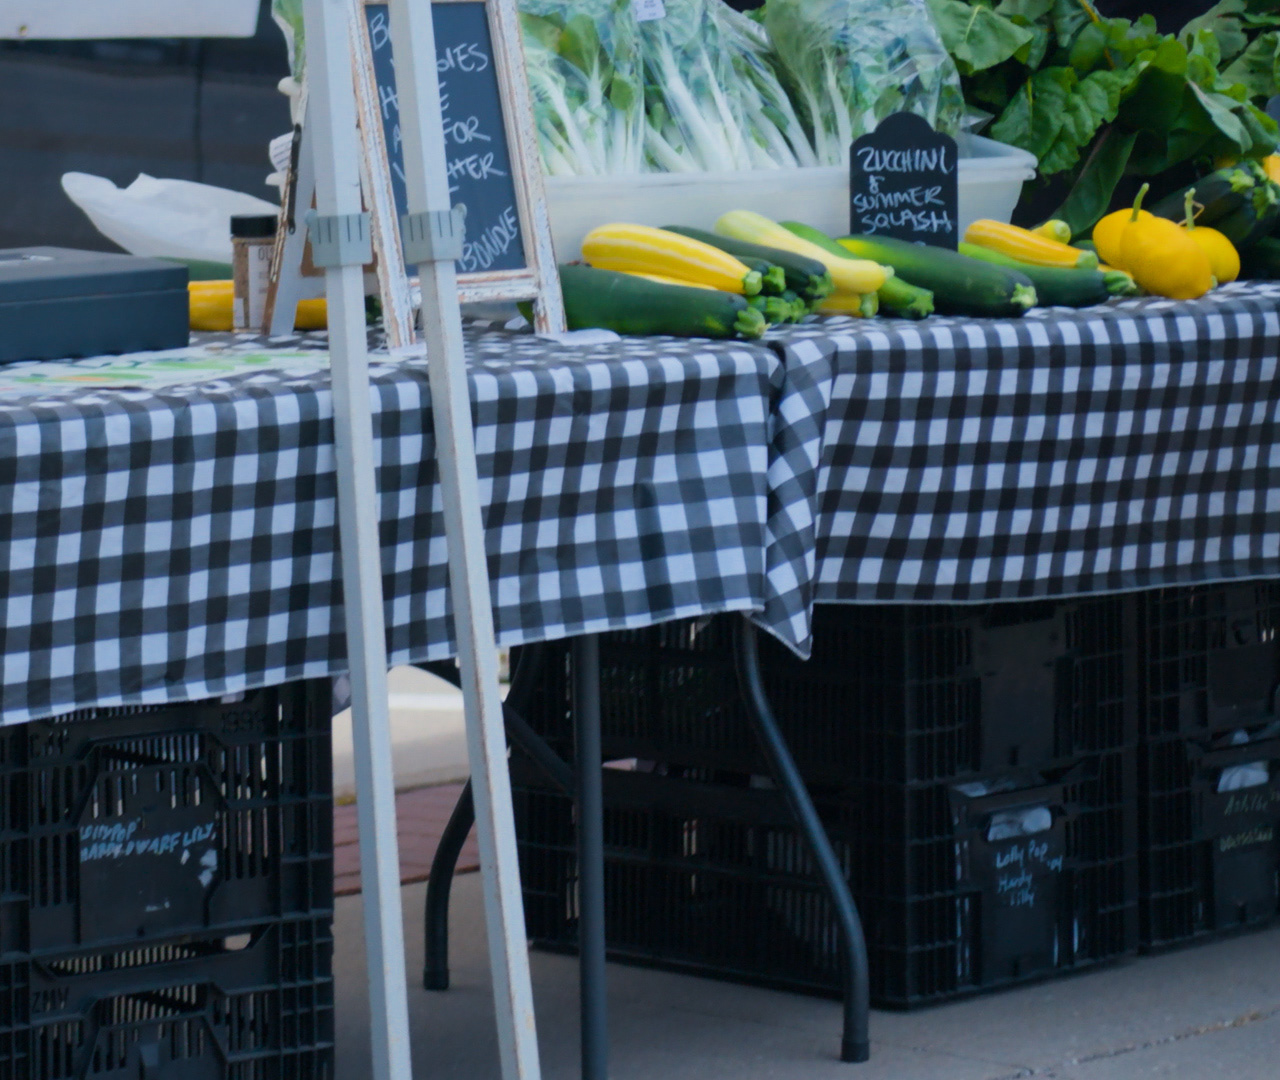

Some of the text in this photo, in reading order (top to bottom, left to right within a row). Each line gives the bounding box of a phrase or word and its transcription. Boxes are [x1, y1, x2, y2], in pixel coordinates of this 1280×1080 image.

[857, 146, 954, 175] ZUCCHINI
[853, 185, 945, 213] SUMMER
[861, 208, 953, 235] SQUASH
